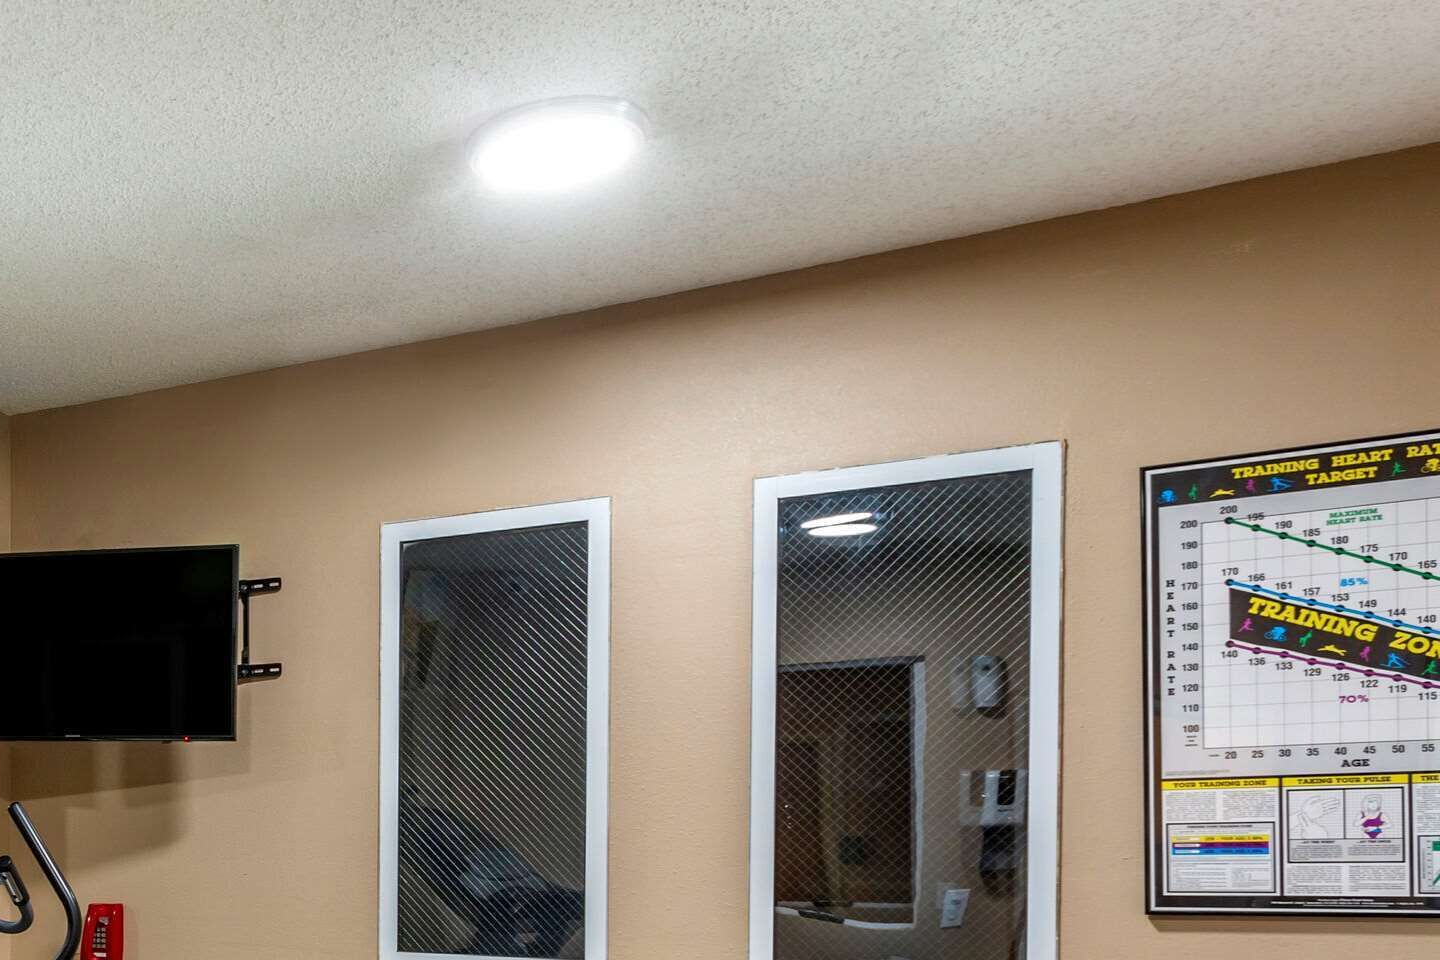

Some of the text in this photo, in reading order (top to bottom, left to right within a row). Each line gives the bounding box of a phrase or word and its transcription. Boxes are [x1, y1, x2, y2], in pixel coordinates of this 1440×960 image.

[1232, 458, 1320, 479] TRAINING
[1331, 449, 1393, 468] HEART
[1305, 466, 1378, 485] TARGET
[1220, 505, 1238, 514] 200
[1248, 512, 1264, 521] 195
[1180, 520, 1198, 529] 200
[1275, 520, 1293, 529] 190
[1303, 528, 1320, 537] 185
[1331, 536, 1349, 545] 180
[1181, 541, 1198, 550] 190
[1360, 544, 1379, 553] 175
[1389, 552, 1408, 561] 170
[1181, 561, 1198, 570] 180
[1418, 560, 1437, 569] 165
[1221, 567, 1239, 576] 170
[1181, 581, 1198, 590] 170
[1275, 581, 1293, 590] 161
[1340, 577, 1368, 587] 85%
[1303, 587, 1320, 596] 157
[1331, 593, 1349, 602] 153
[1182, 602, 1198, 611] 160
[1359, 599, 1377, 608] 149
[1388, 608, 1406, 617] 144
[1248, 597, 1378, 641] TRAINING
[1417, 615, 1436, 624] 140
[1182, 622, 1198, 631] 150
[1182, 642, 1199, 651] 140
[1221, 650, 1238, 659] 140
[1182, 663, 1199, 672] 130
[1275, 661, 1293, 670] 133
[1182, 683, 1199, 692] 120
[1360, 679, 1378, 688] 122
[1388, 684, 1407, 693] 119
[1339, 694, 1369, 703] 70%
[1418, 691, 1438, 701] 115
[1182, 704, 1199, 712] 110
[1182, 724, 1199, 733] 100
[1225, 751, 1237, 759] 20
[1251, 750, 1264, 758] 25
[1278, 749, 1291, 757] 30
[1306, 748, 1320, 756] 35
[1334, 746, 1347, 755] 40
[1363, 745, 1376, 754] 45
[1392, 744, 1405, 753] 50
[1421, 743, 1435, 752] 55
[1341, 758, 1370, 767] AGE
